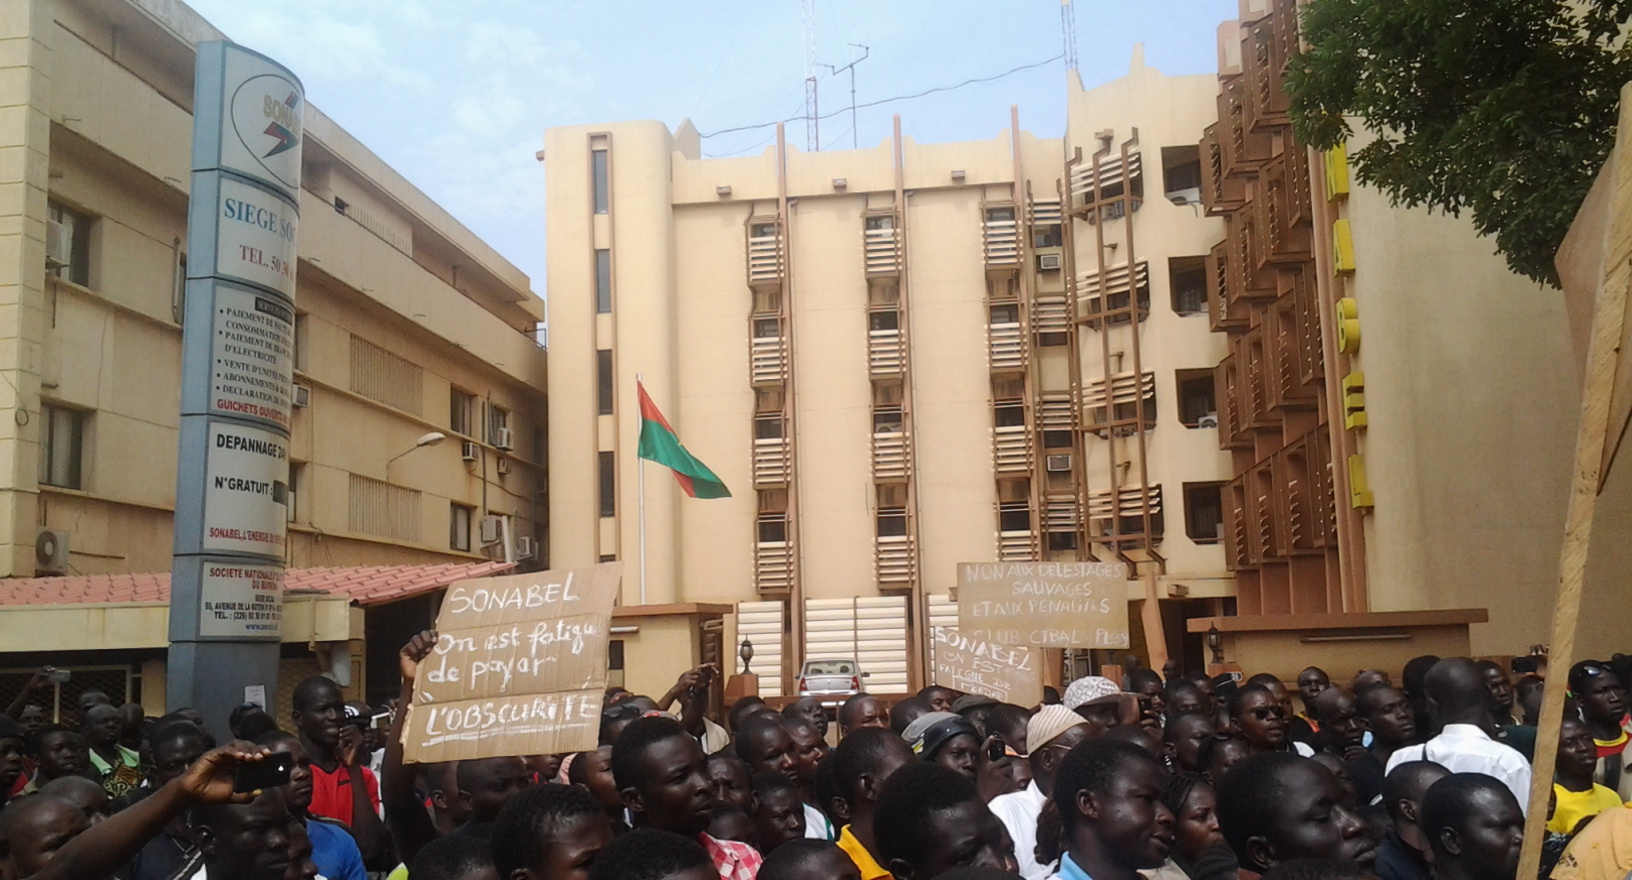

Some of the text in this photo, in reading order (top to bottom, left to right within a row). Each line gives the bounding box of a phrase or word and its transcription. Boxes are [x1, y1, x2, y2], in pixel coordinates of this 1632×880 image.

[224, 197, 277, 233] SIEGE
[239, 244, 269, 268] TEL.
[226, 307, 265, 325] PAIEMENT
[225, 331, 264, 347] PAIEMENT
[224, 359, 251, 371] VENTE
[217, 398, 258, 415] GUICHETS
[216, 433, 277, 458] DEPANNAGE
[209, 567, 243, 578] SOCIETE
[966, 562, 1122, 583] NON AUX DELESTAGES
[451, 571, 581, 614] SONABEL
[1012, 581, 1093, 597] SAUVAGES
[972, 601, 992, 617] ET
[993, 600, 1023, 616] AUX
[484, 626, 520, 650] est
[935, 626, 1032, 671] SONABEL
[427, 656, 460, 682] de
